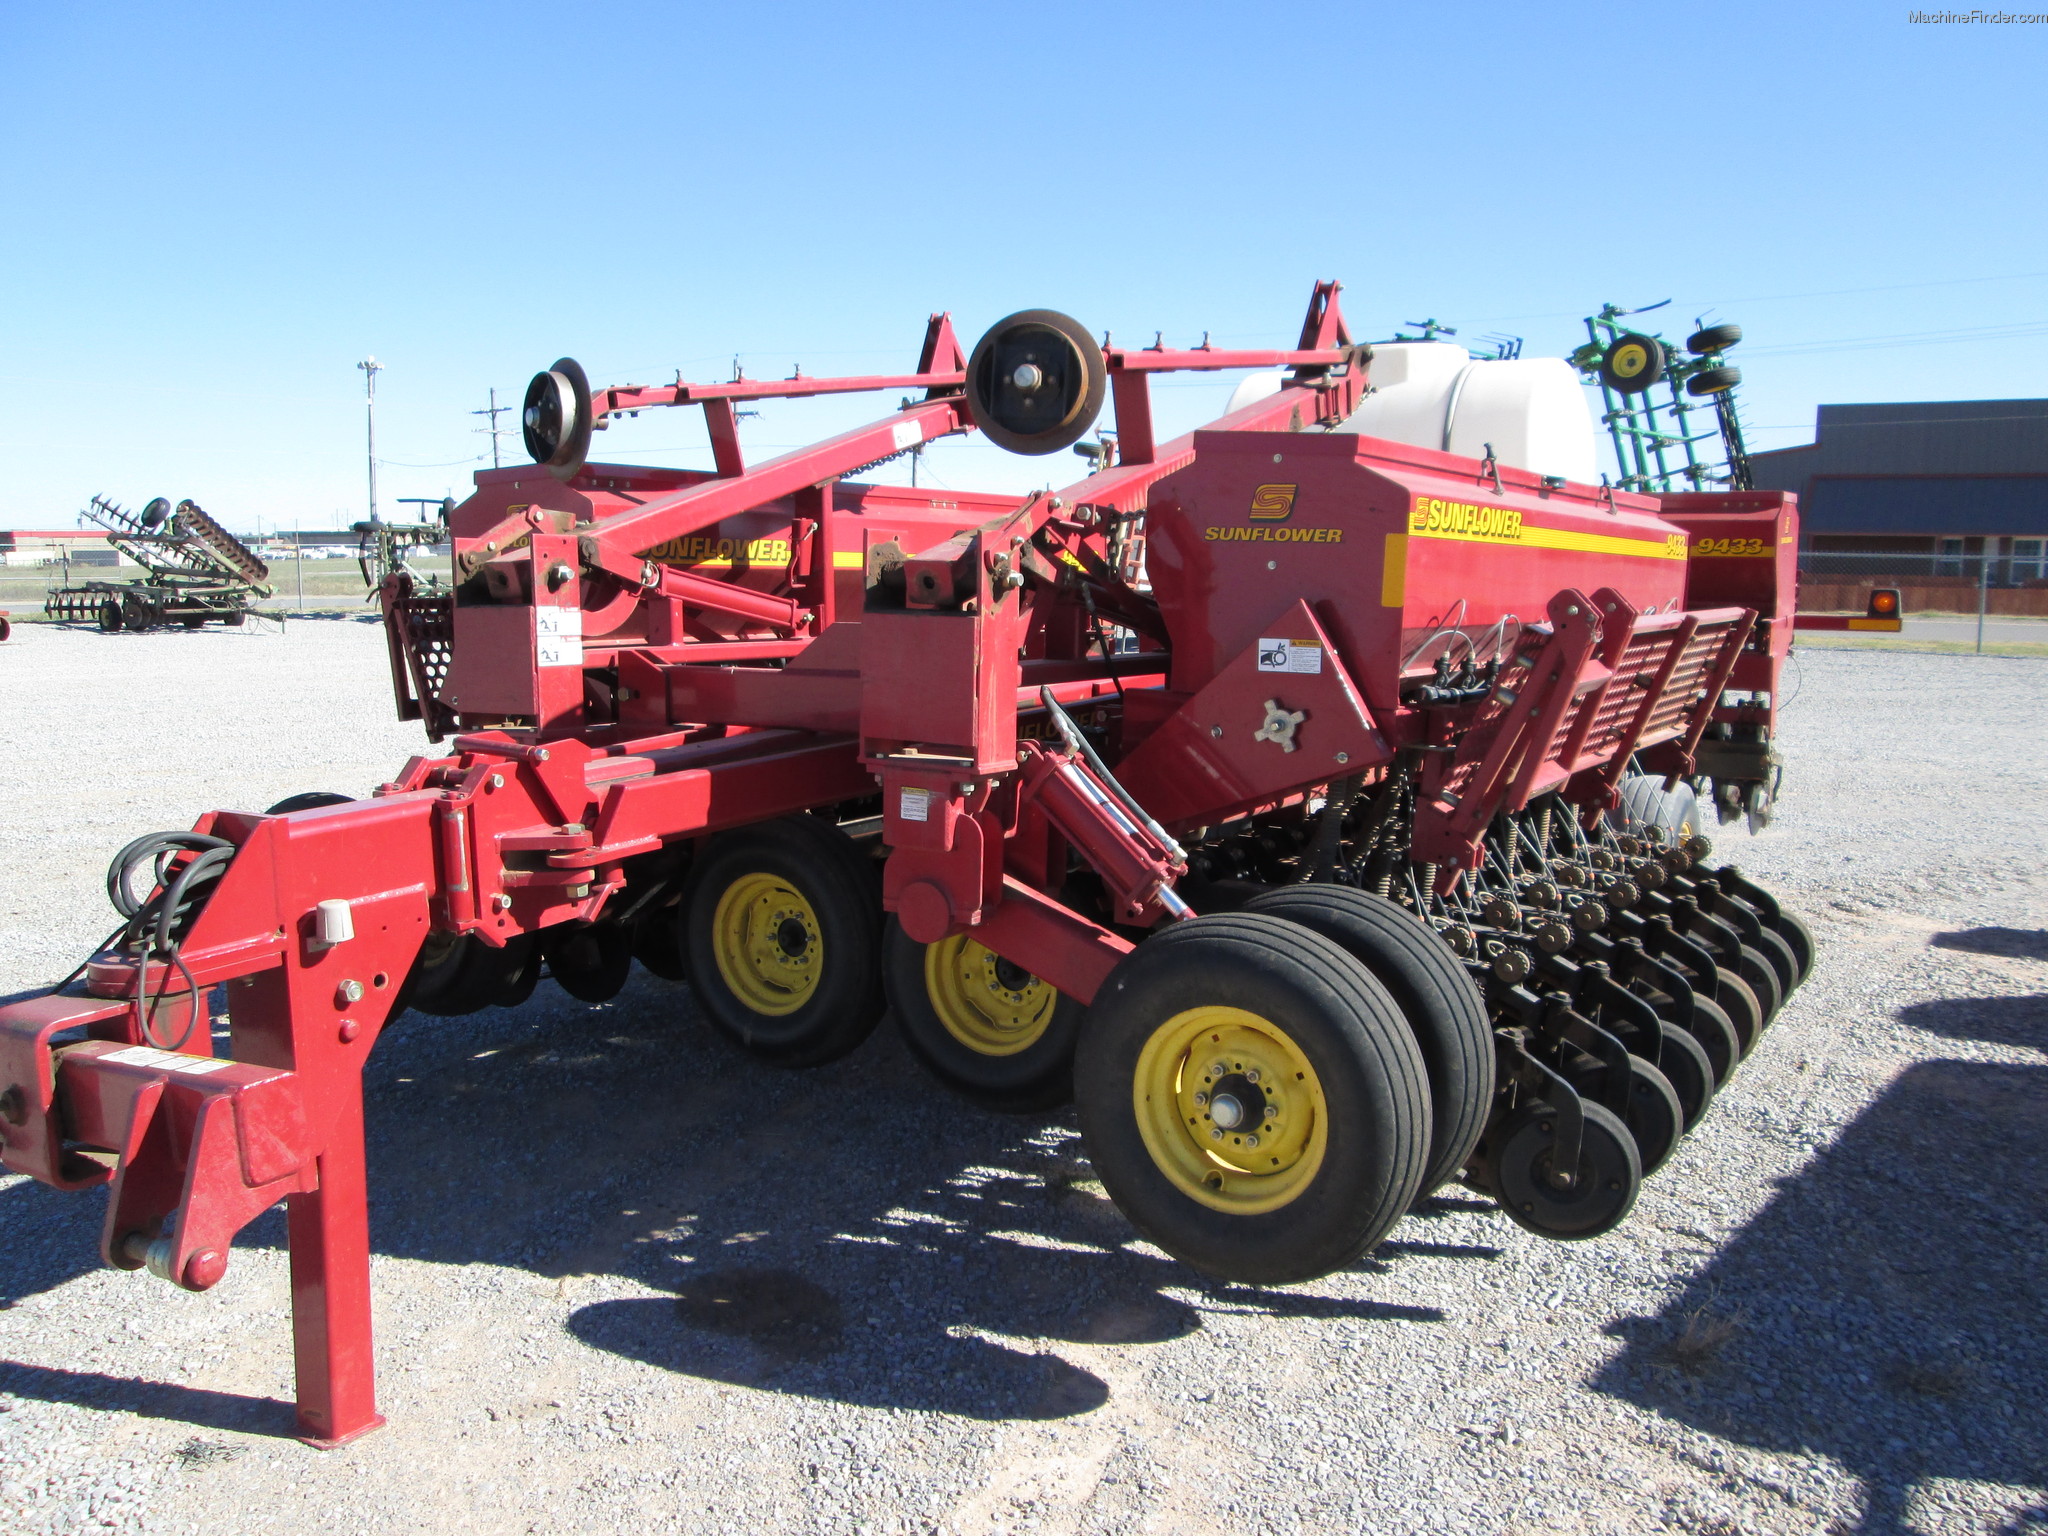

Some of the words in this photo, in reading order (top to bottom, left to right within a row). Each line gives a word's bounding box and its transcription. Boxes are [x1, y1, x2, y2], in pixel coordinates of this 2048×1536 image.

[1428, 499, 1522, 539] SUNFLOWER
[1204, 526, 1344, 543] SUNFLOWER
[1697, 538, 1763, 555] 9433
